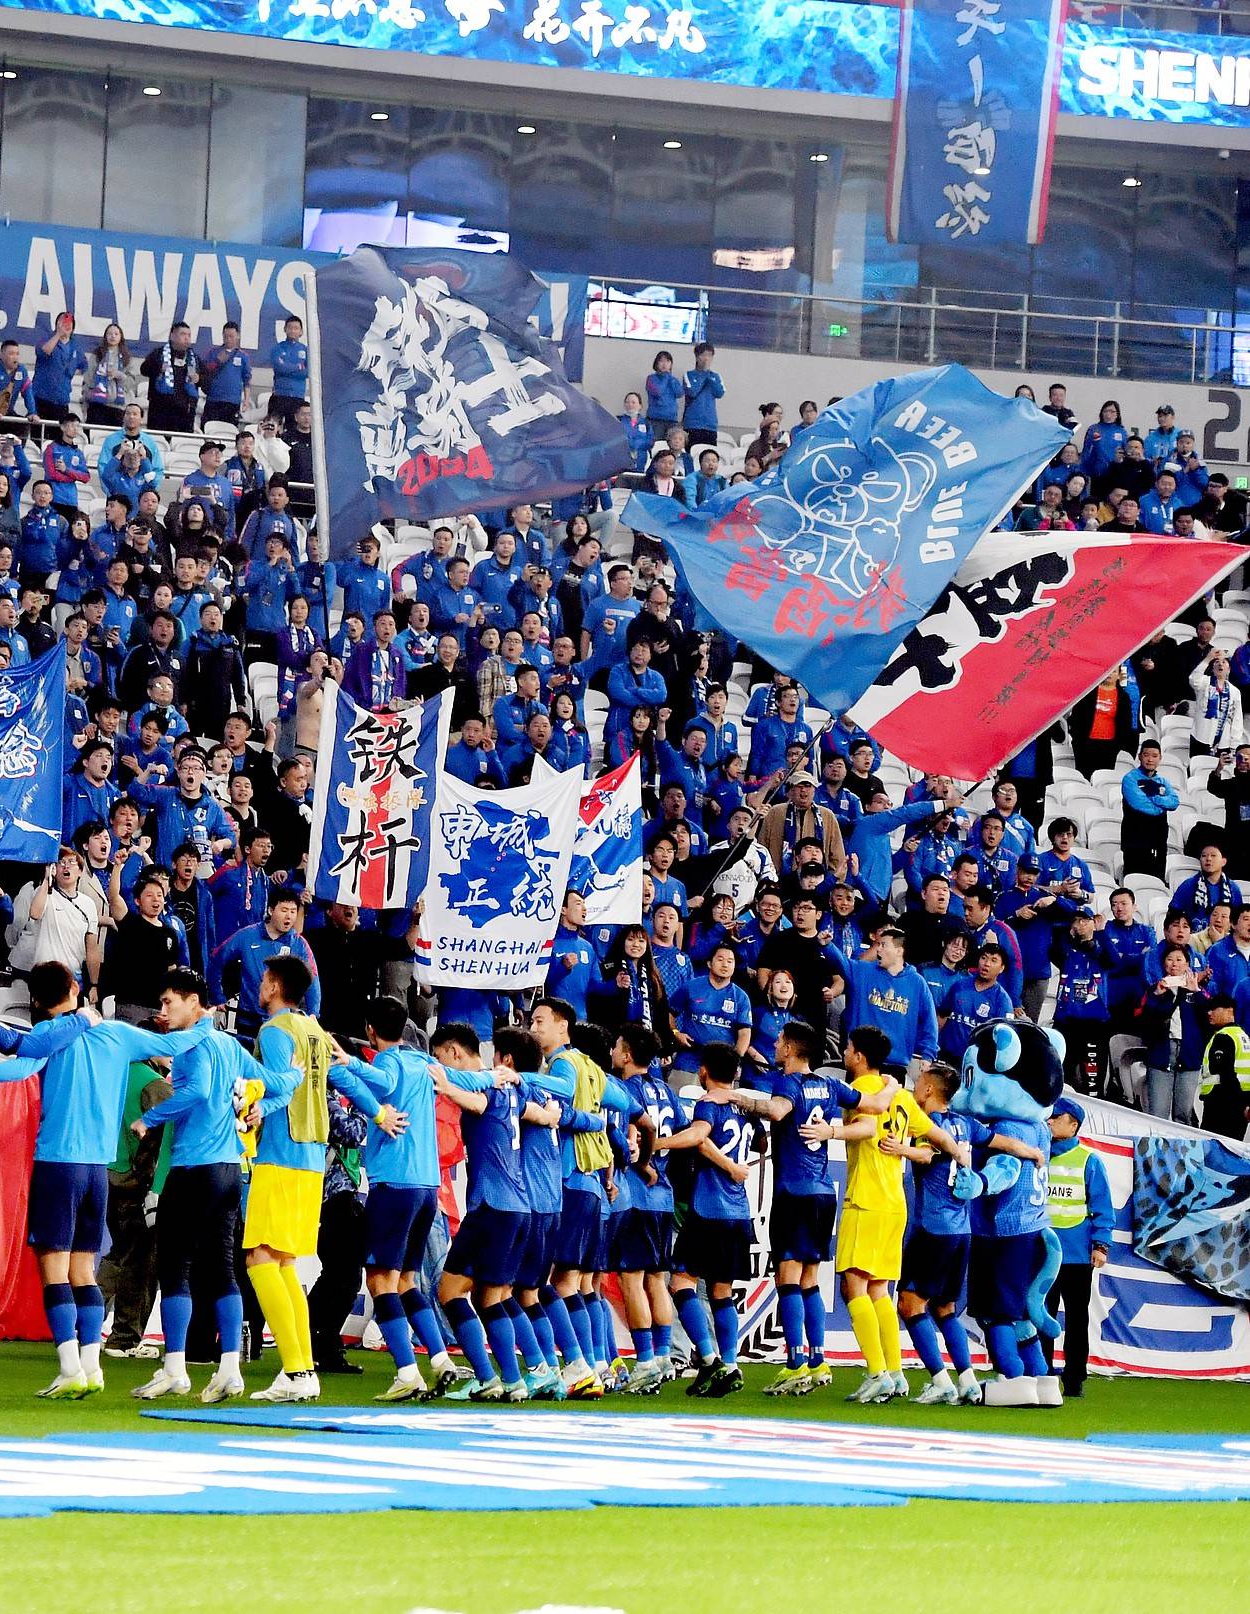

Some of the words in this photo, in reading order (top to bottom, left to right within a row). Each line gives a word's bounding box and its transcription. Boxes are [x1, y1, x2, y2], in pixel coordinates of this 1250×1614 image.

[1202, 388, 1250, 462] 2
[731, 883, 740, 898] 5
[437, 935, 541, 955] SHANGHAI
[438, 957, 530, 977] SHENHUA
[720, 1117, 756, 1161] 20
